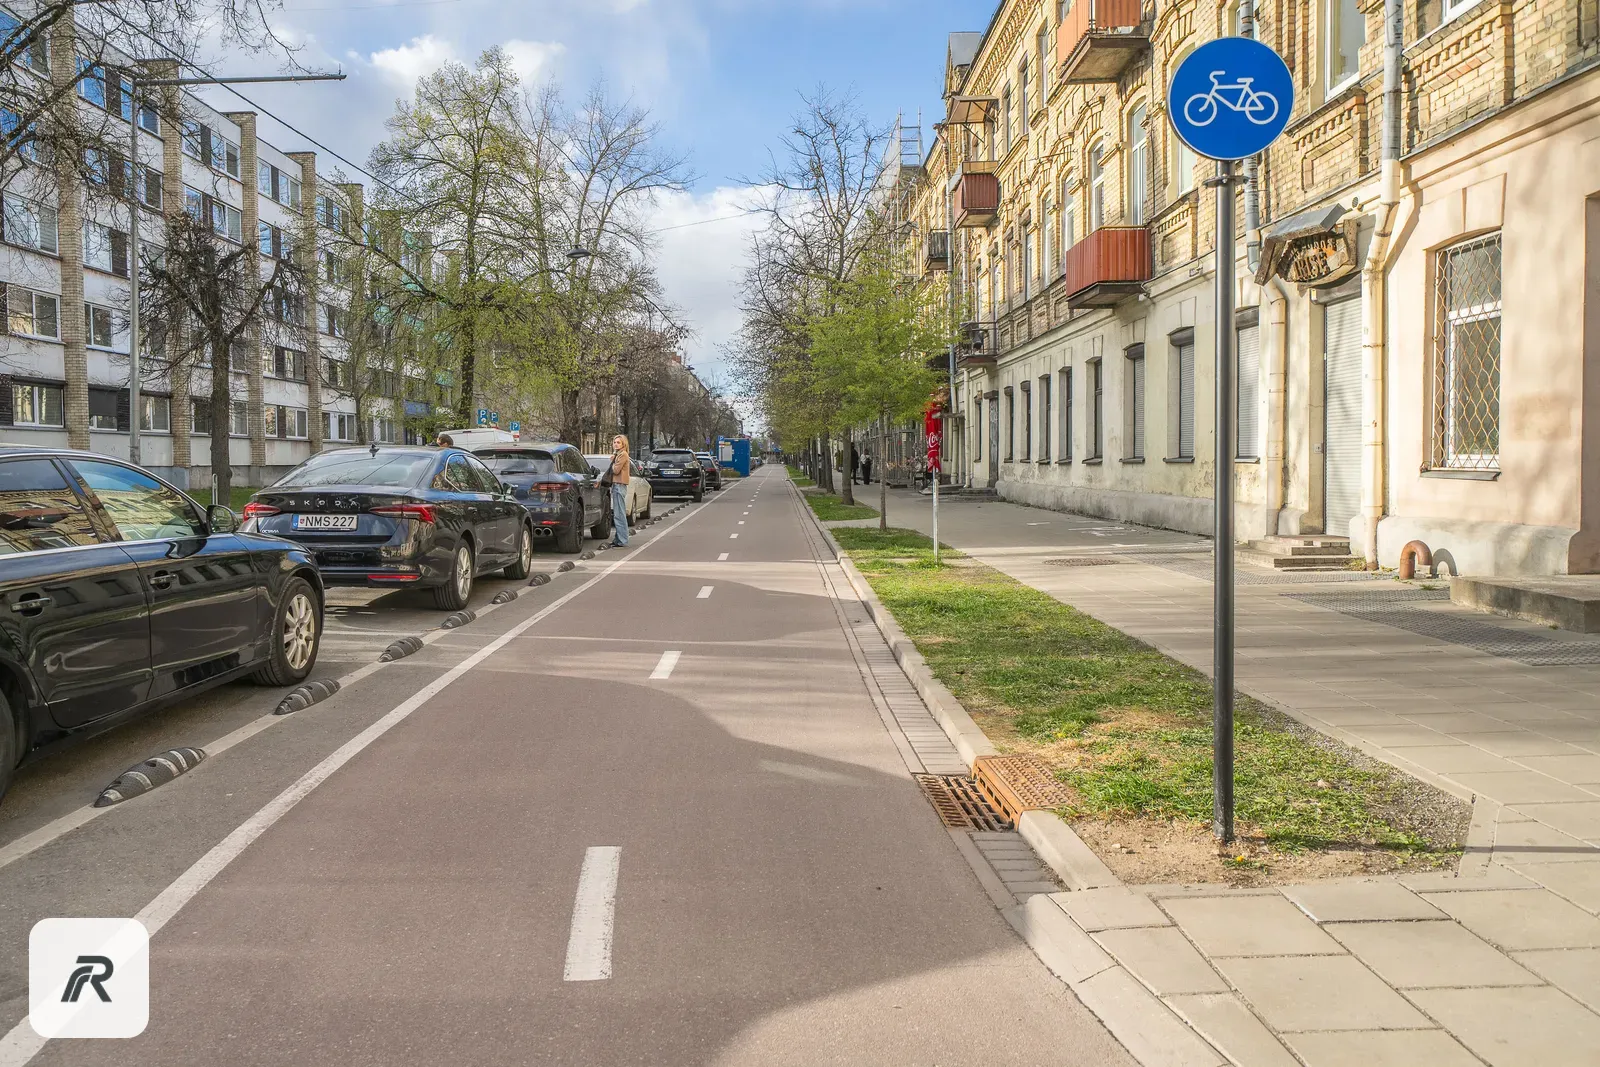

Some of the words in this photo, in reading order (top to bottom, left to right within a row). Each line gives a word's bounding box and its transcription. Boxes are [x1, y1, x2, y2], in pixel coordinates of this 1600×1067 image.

[480, 410, 486, 418] P
[491, 412, 497, 420] P
[512, 422, 518, 430] P
[305, 516, 331, 527] NMS
[332, 516, 355, 527] 227
